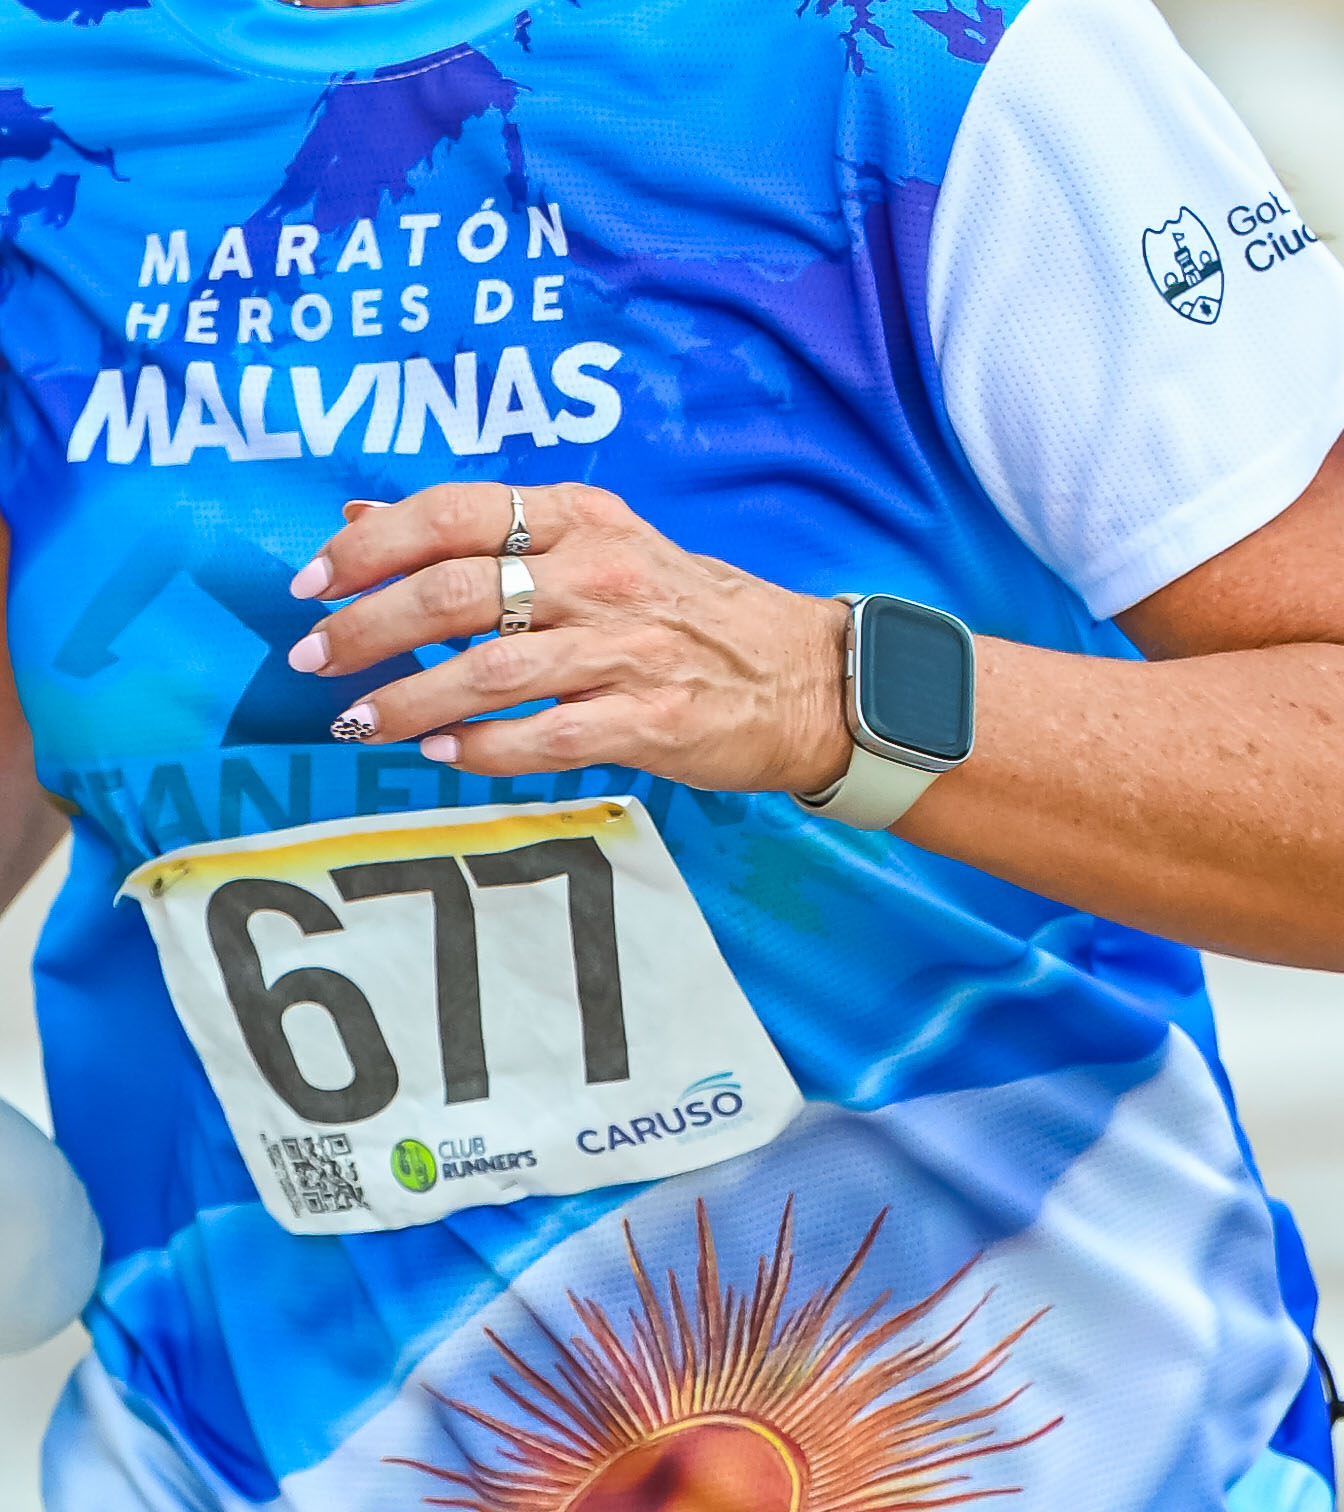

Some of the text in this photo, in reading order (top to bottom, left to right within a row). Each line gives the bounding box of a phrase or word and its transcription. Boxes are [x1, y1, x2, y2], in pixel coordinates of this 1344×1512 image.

[138, 197, 569, 287] MARATÓN
[125, 275, 565, 345] HÉROES DE
[67, 341, 623, 467] MALVINAS
[206, 836, 630, 1125] 677
[438, 1136, 486, 1160] CLUB
[576, 1091, 744, 1155] CARUSO
